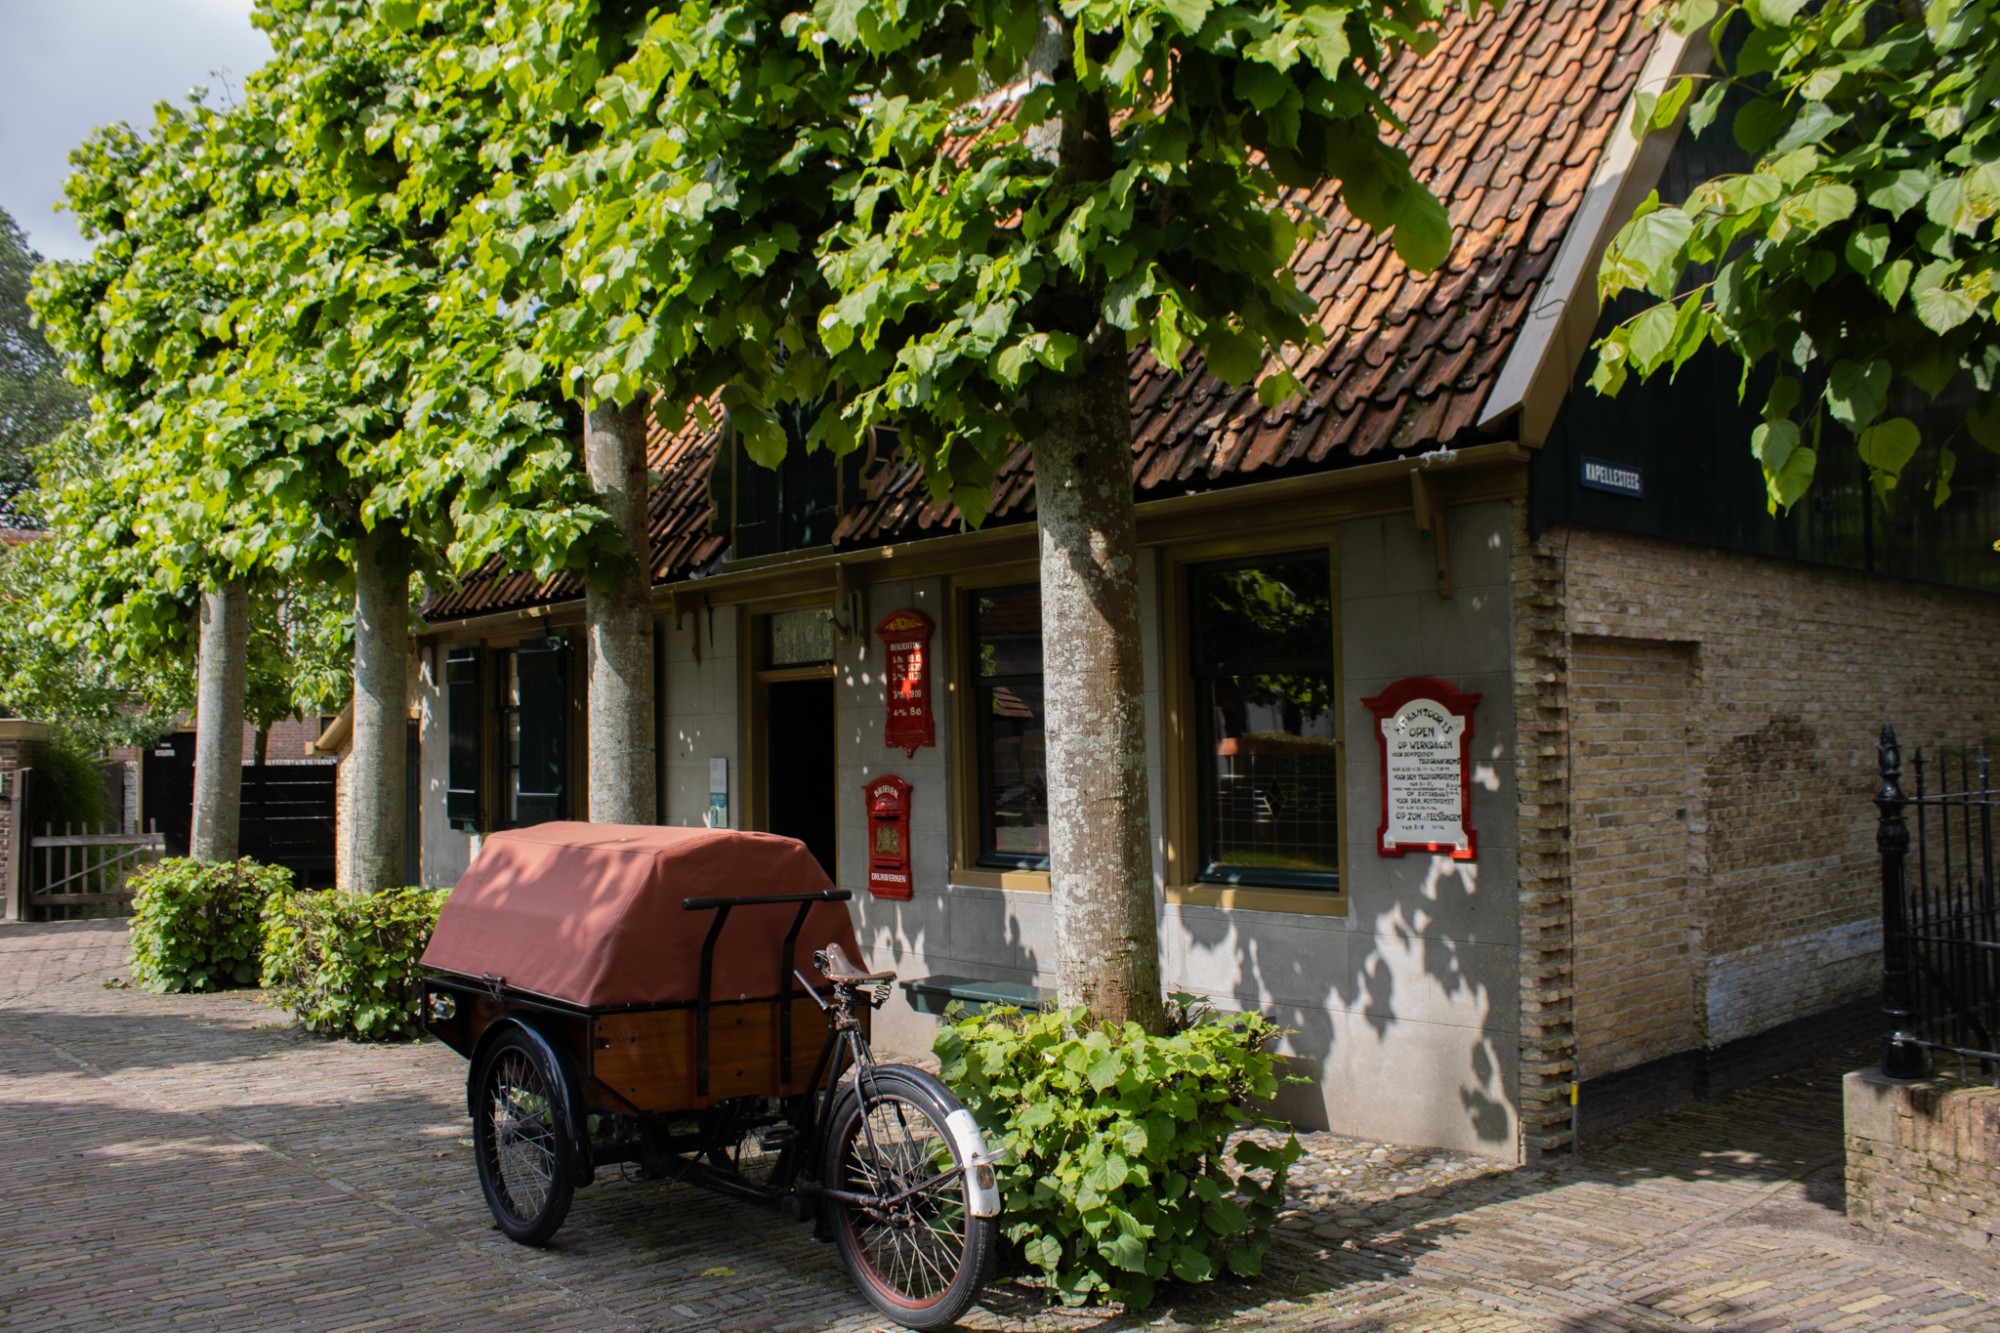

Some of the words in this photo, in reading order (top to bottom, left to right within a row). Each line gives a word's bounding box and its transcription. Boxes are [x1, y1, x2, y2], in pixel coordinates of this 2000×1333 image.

[1586, 463, 1640, 490] KAPELLESTEEG
[1405, 708, 1444, 725] KANTOOR
[1441, 721, 1453, 734] IS
[1409, 727, 1435, 738] OPEN
[1397, 741, 1407, 749] OP
[1409, 740, 1453, 750] WERKDAGEN
[874, 786, 899, 799] BRIEVEN
[1396, 812, 1406, 820] OP
[871, 872, 906, 883] DRUKWERKEN
